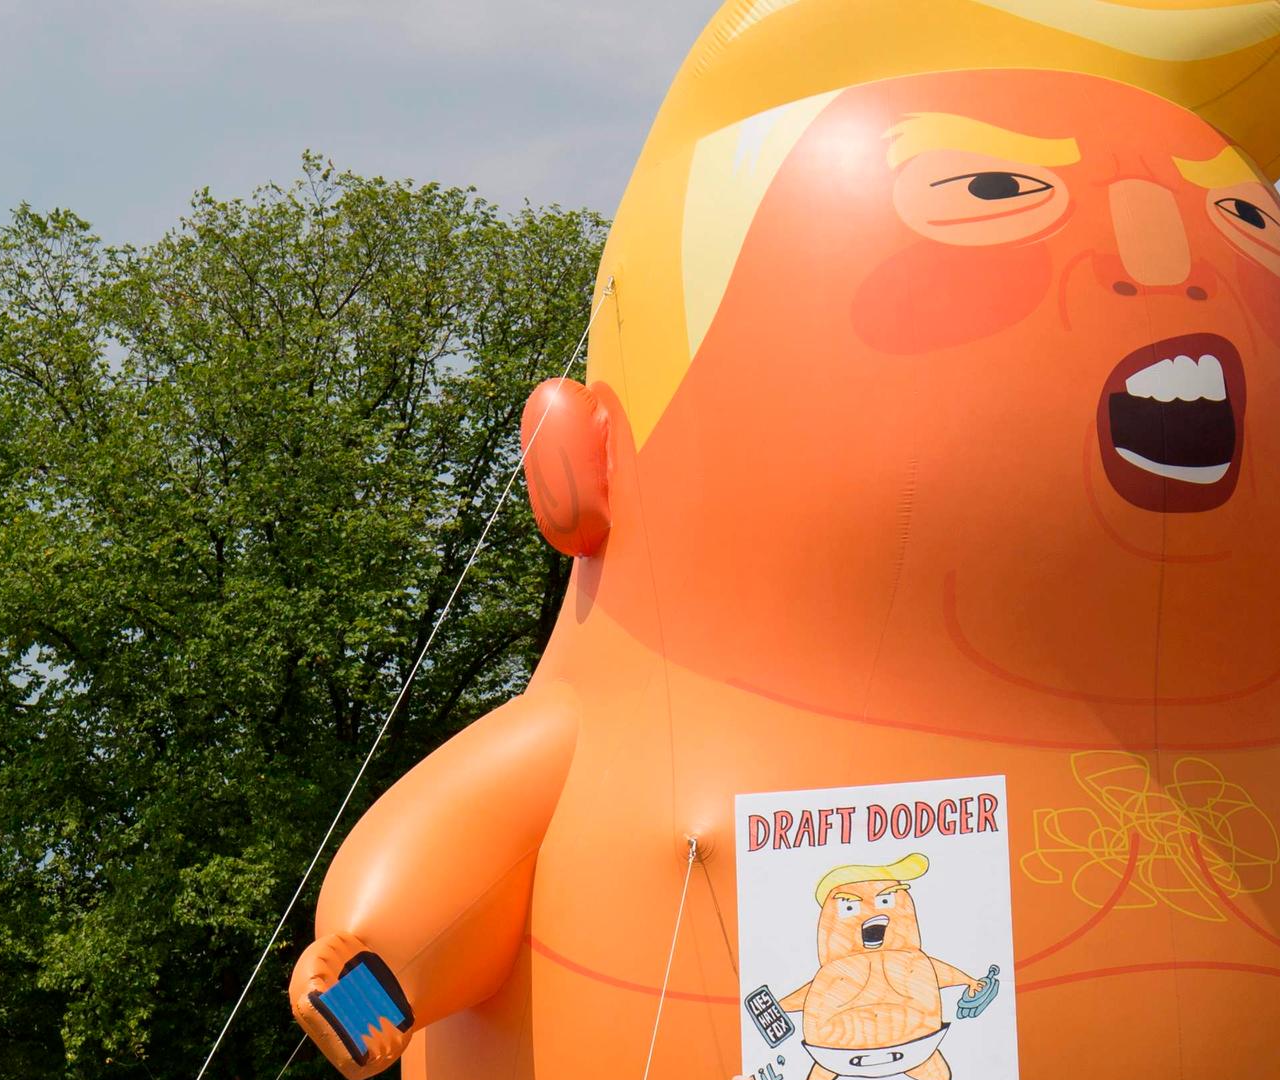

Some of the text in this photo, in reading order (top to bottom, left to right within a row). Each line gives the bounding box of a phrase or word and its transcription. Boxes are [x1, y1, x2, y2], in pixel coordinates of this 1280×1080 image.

[748, 793, 999, 852] DRAFT DODGER
[750, 992, 772, 1015] LIES
[758, 1006, 781, 1028] HATE
[766, 1019, 789, 1042] FOX
